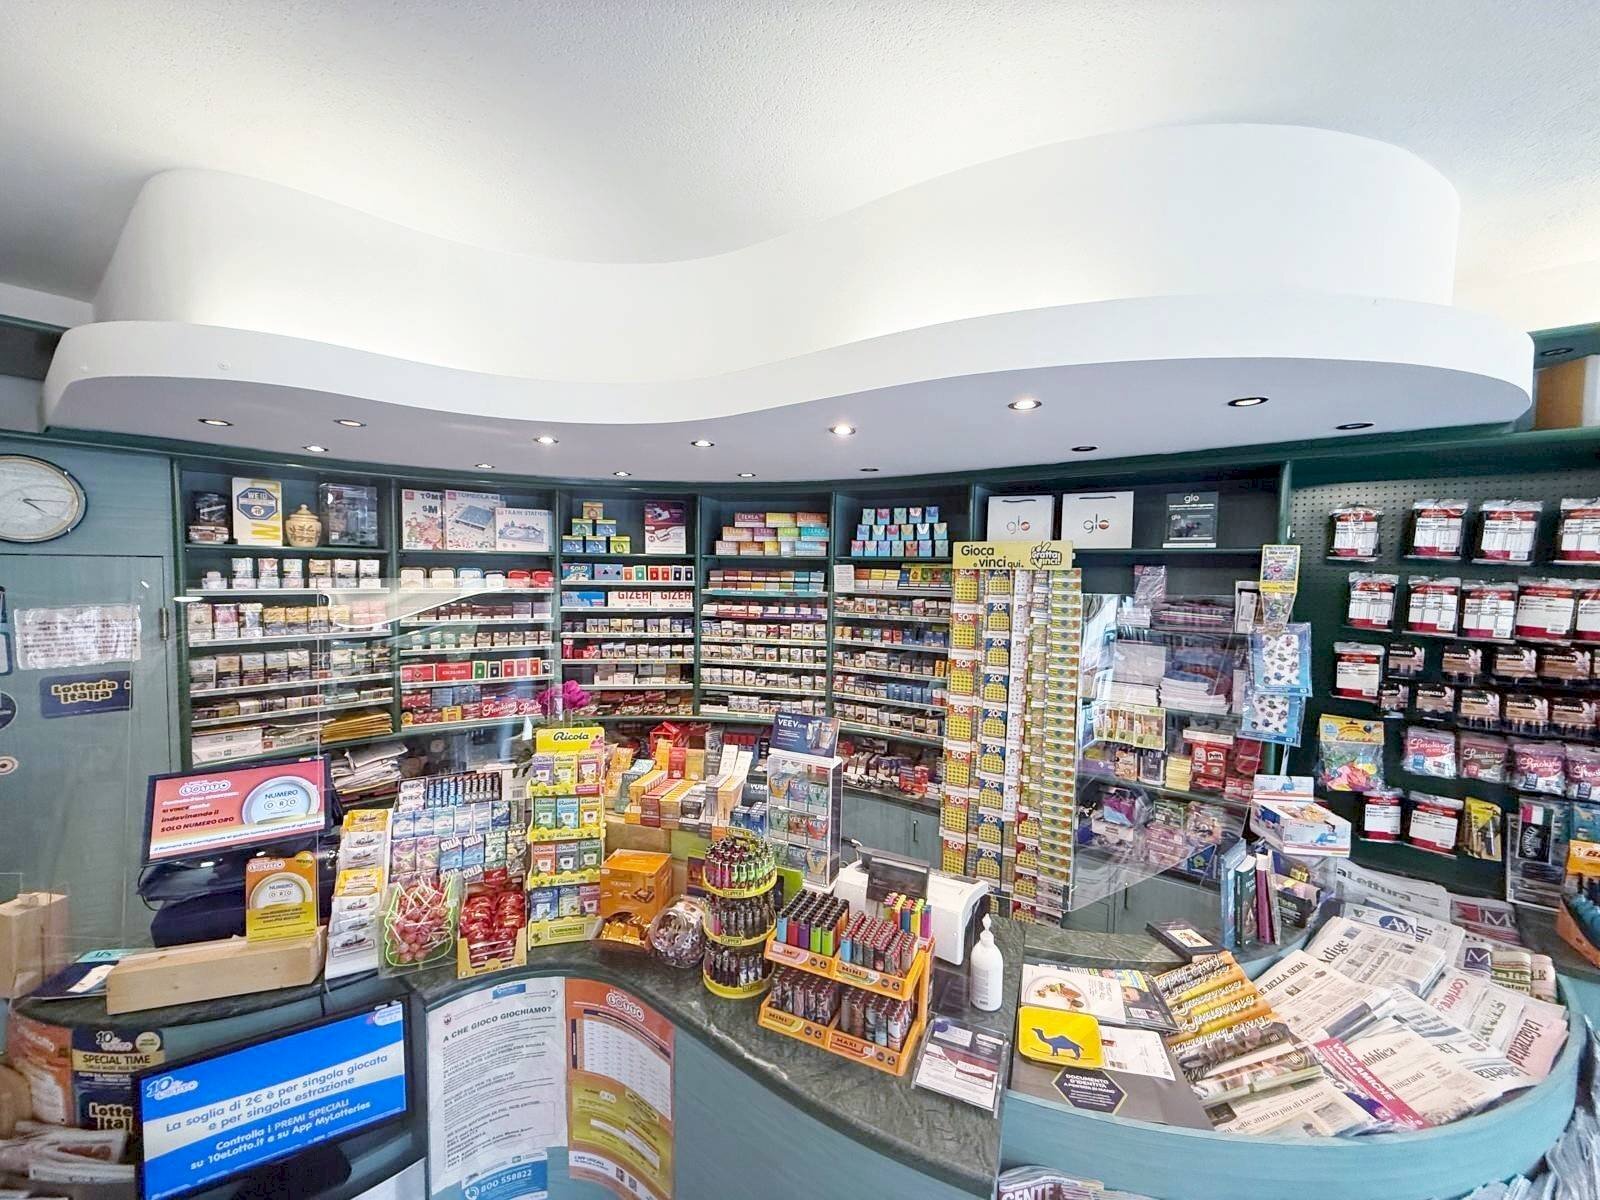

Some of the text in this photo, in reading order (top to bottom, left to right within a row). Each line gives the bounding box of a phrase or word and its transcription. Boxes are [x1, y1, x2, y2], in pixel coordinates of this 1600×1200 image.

[1184, 494, 1200, 504] glo
[1007, 516, 1030, 534] glo
[1083, 514, 1109, 533] glo
[961, 545, 994, 556] Gioca
[979, 556, 1006, 568] vinci
[52, 680, 118, 694] Lotteria
[62, 690, 112, 702] Italia
[482, 701, 518, 716] Smoking
[778, 718, 798, 727] VEEV
[553, 731, 589, 742] Ricola
[1410, 738, 1451, 754] Smoking
[1464, 748, 1504, 763] Smoking
[264, 790, 298, 800] NUMERO
[160, 816, 234, 832] SOLO NUMERO ORO
[1266, 961, 1308, 991] DELLA SERA
[451, 1026, 469, 1038] CHE
[471, 1015, 498, 1030] GIOCO
[500, 1006, 552, 1020] GIOCHIAMO?
[82, 1054, 152, 1065] SPECIAL TIME
[1332, 1042, 1395, 1100] VOCI AMICHE
[166, 1056, 388, 1132] La soglia di 2€ è per singola giocata
[208, 1076, 355, 1132] e per singola estrazione
[216, 1128, 265, 1151] Controlla
[274, 1114, 306, 1132] PREMI
[308, 1098, 349, 1120] SPECIALI
[190, 1101, 371, 1170] su 10eLotto.it e su App MyLotteries
[481, 1179, 498, 1192] 800
